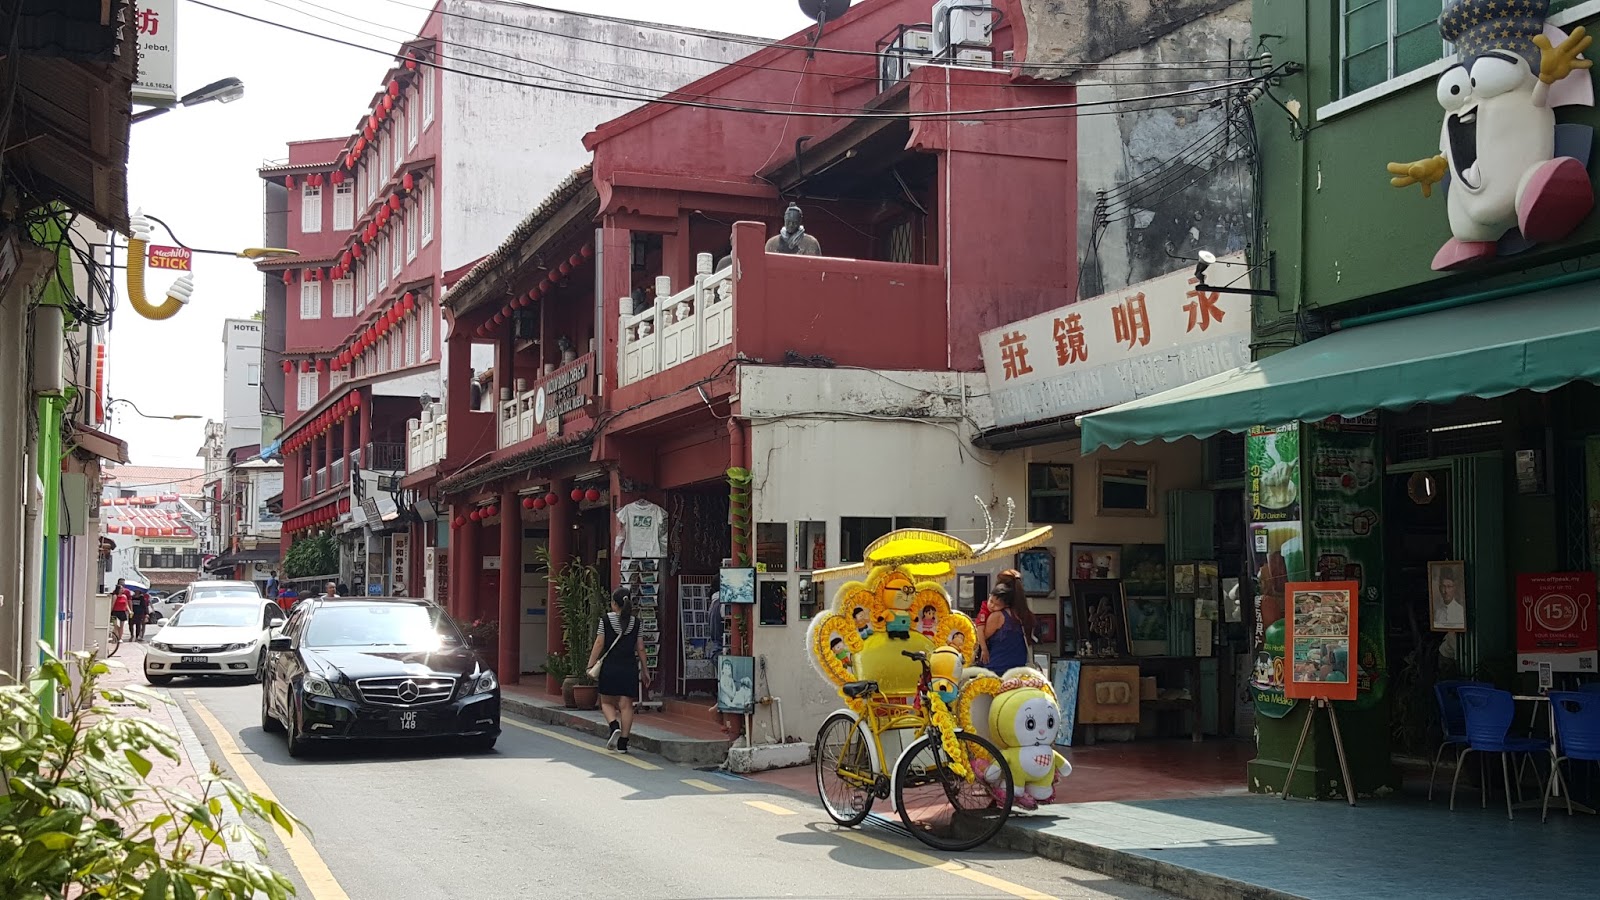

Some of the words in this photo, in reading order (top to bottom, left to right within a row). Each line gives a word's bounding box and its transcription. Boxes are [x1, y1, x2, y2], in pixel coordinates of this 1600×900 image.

[144, 43, 170, 52] Jebat,
[150, 256, 188, 270] STICK
[234, 324, 261, 332] HOTEL
[401, 720, 416, 729] 148
